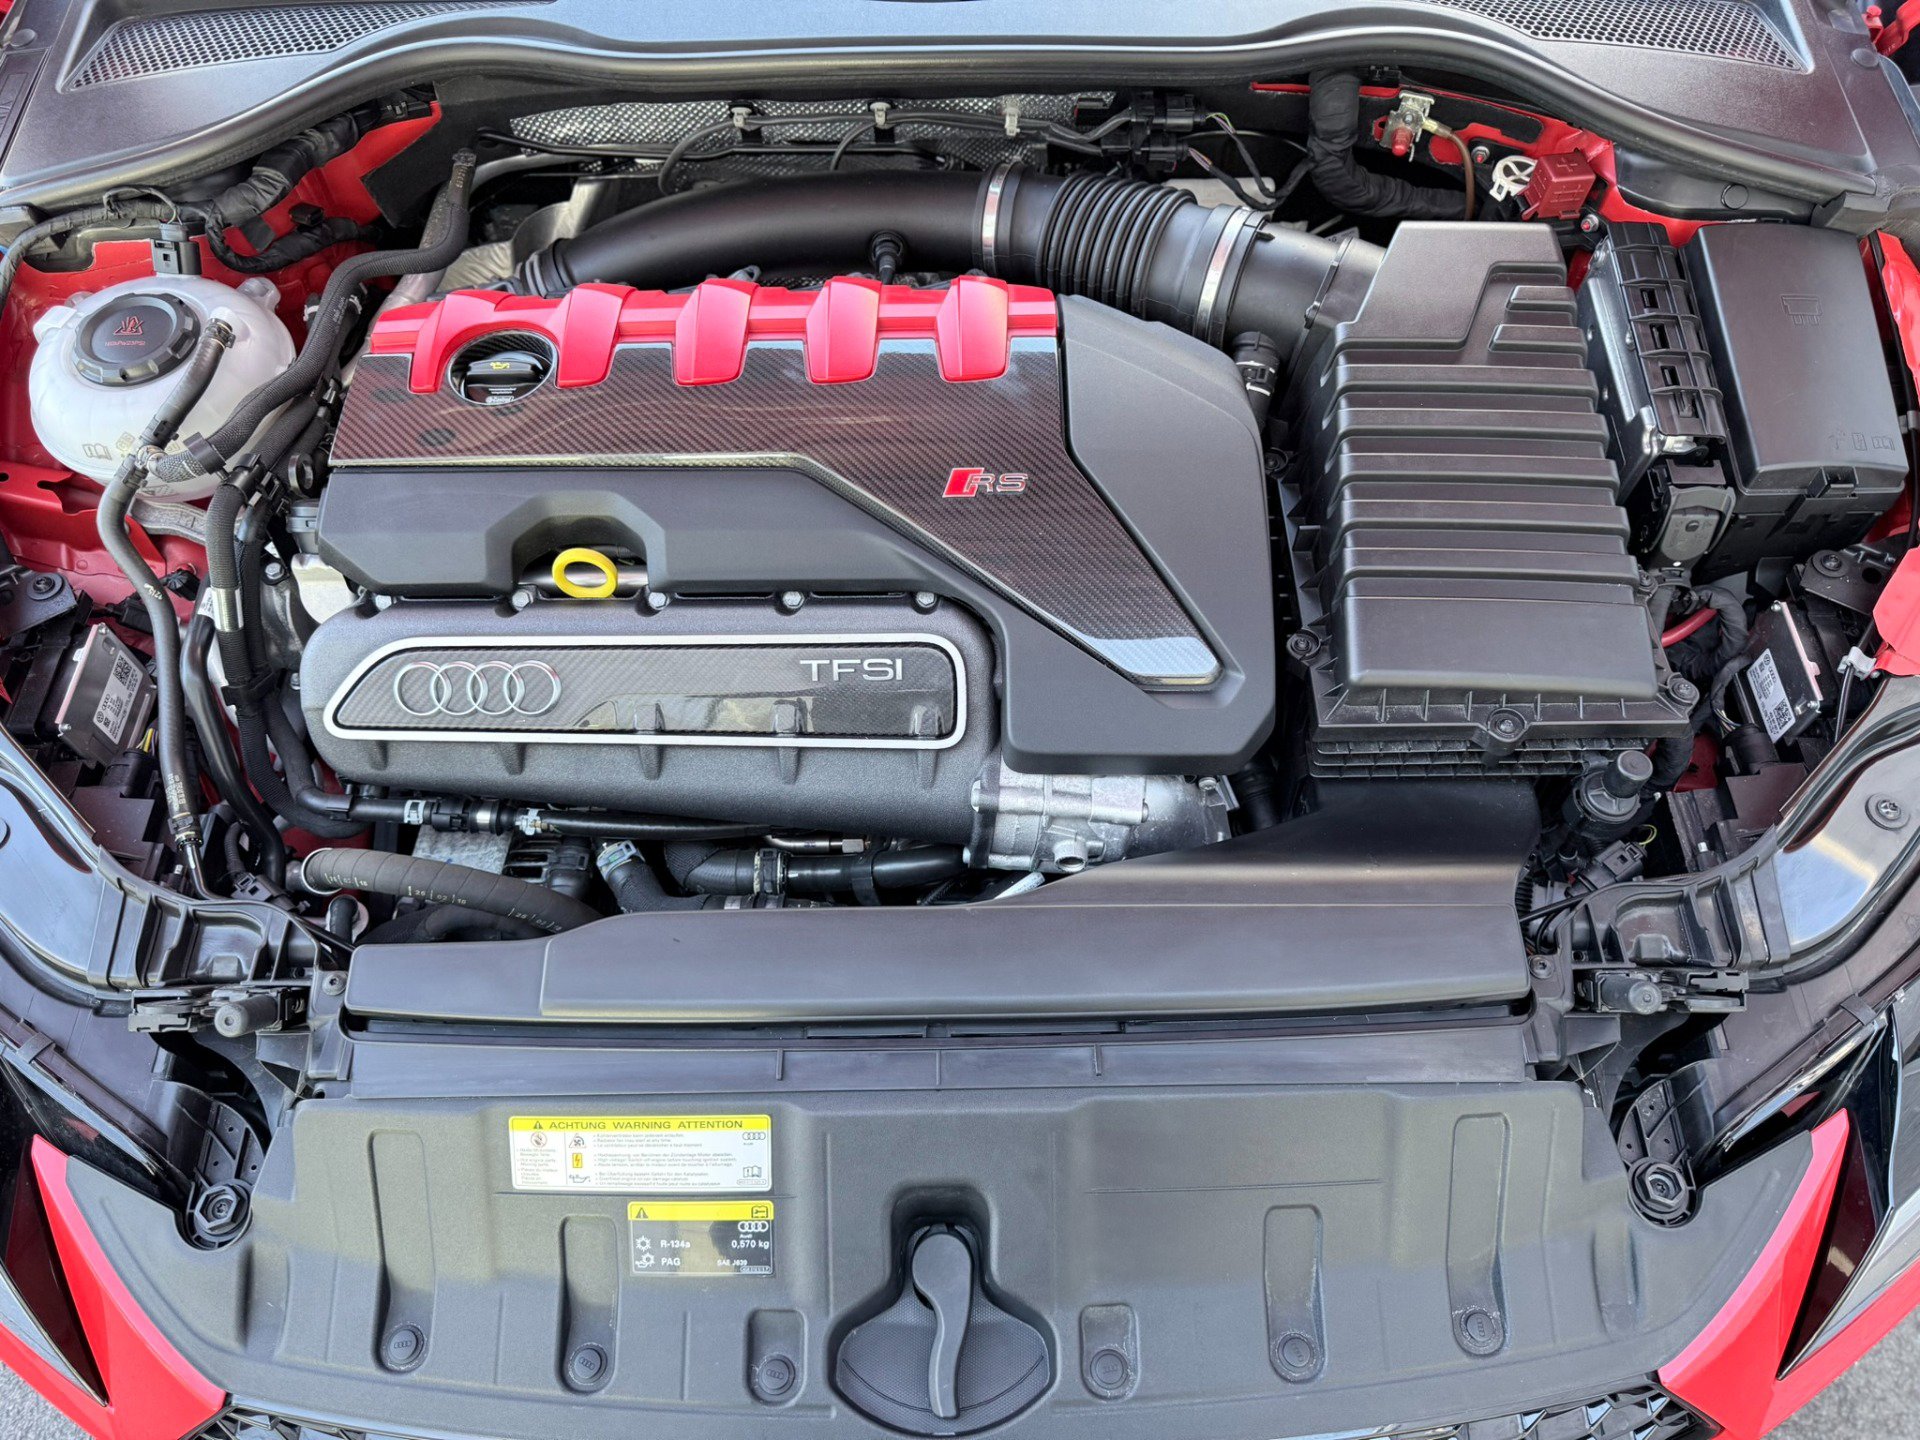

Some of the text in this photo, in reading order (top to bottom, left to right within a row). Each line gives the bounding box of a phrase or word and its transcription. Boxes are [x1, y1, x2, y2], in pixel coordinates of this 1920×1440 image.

[799, 658, 903, 682] TFSI
[549, 1120, 744, 1130] ACHTUNG WARNING ATTENTION
[660, 1239, 770, 1250] R-134a 0,570 kg
[661, 1257, 681, 1266] PAG
